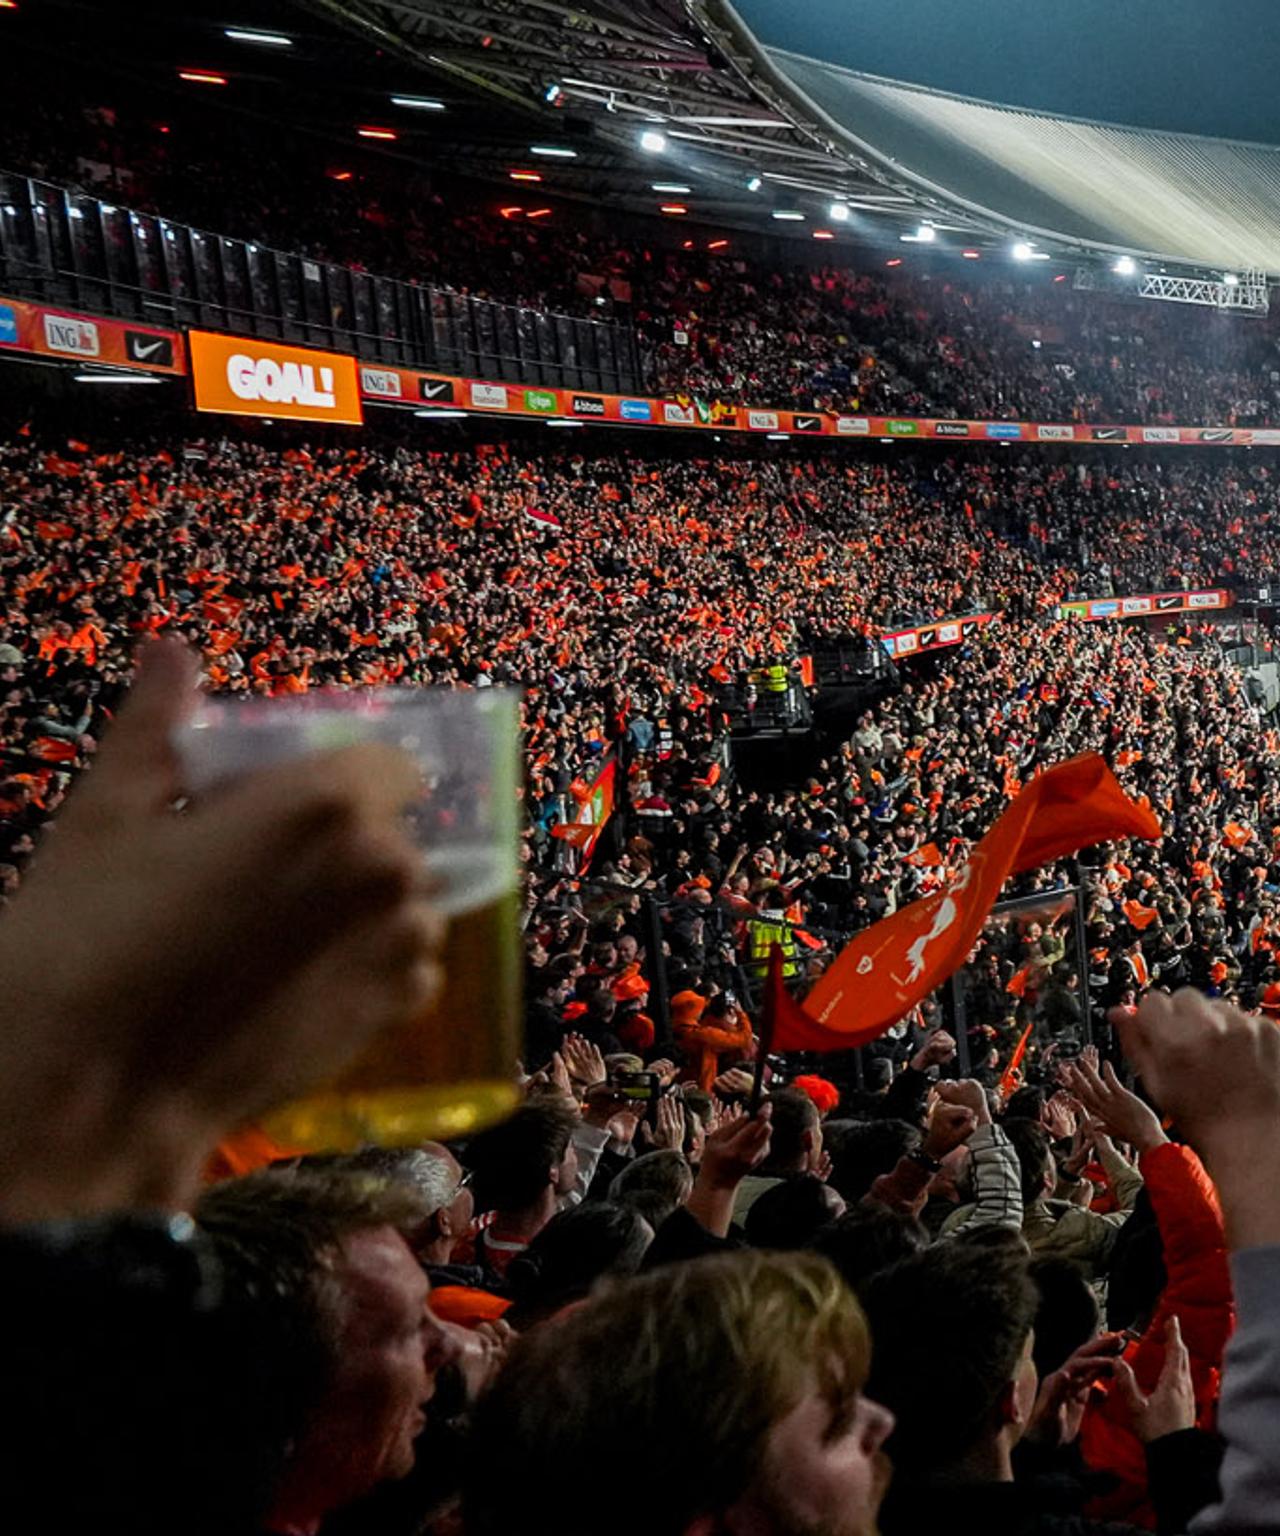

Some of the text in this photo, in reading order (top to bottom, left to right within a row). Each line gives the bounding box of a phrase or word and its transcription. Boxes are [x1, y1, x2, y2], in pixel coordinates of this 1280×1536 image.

[48, 322, 77, 348] ING
[227, 354, 336, 408] GOAL!
[364, 373, 385, 393] ING
[1040, 427, 1060, 438] ING
